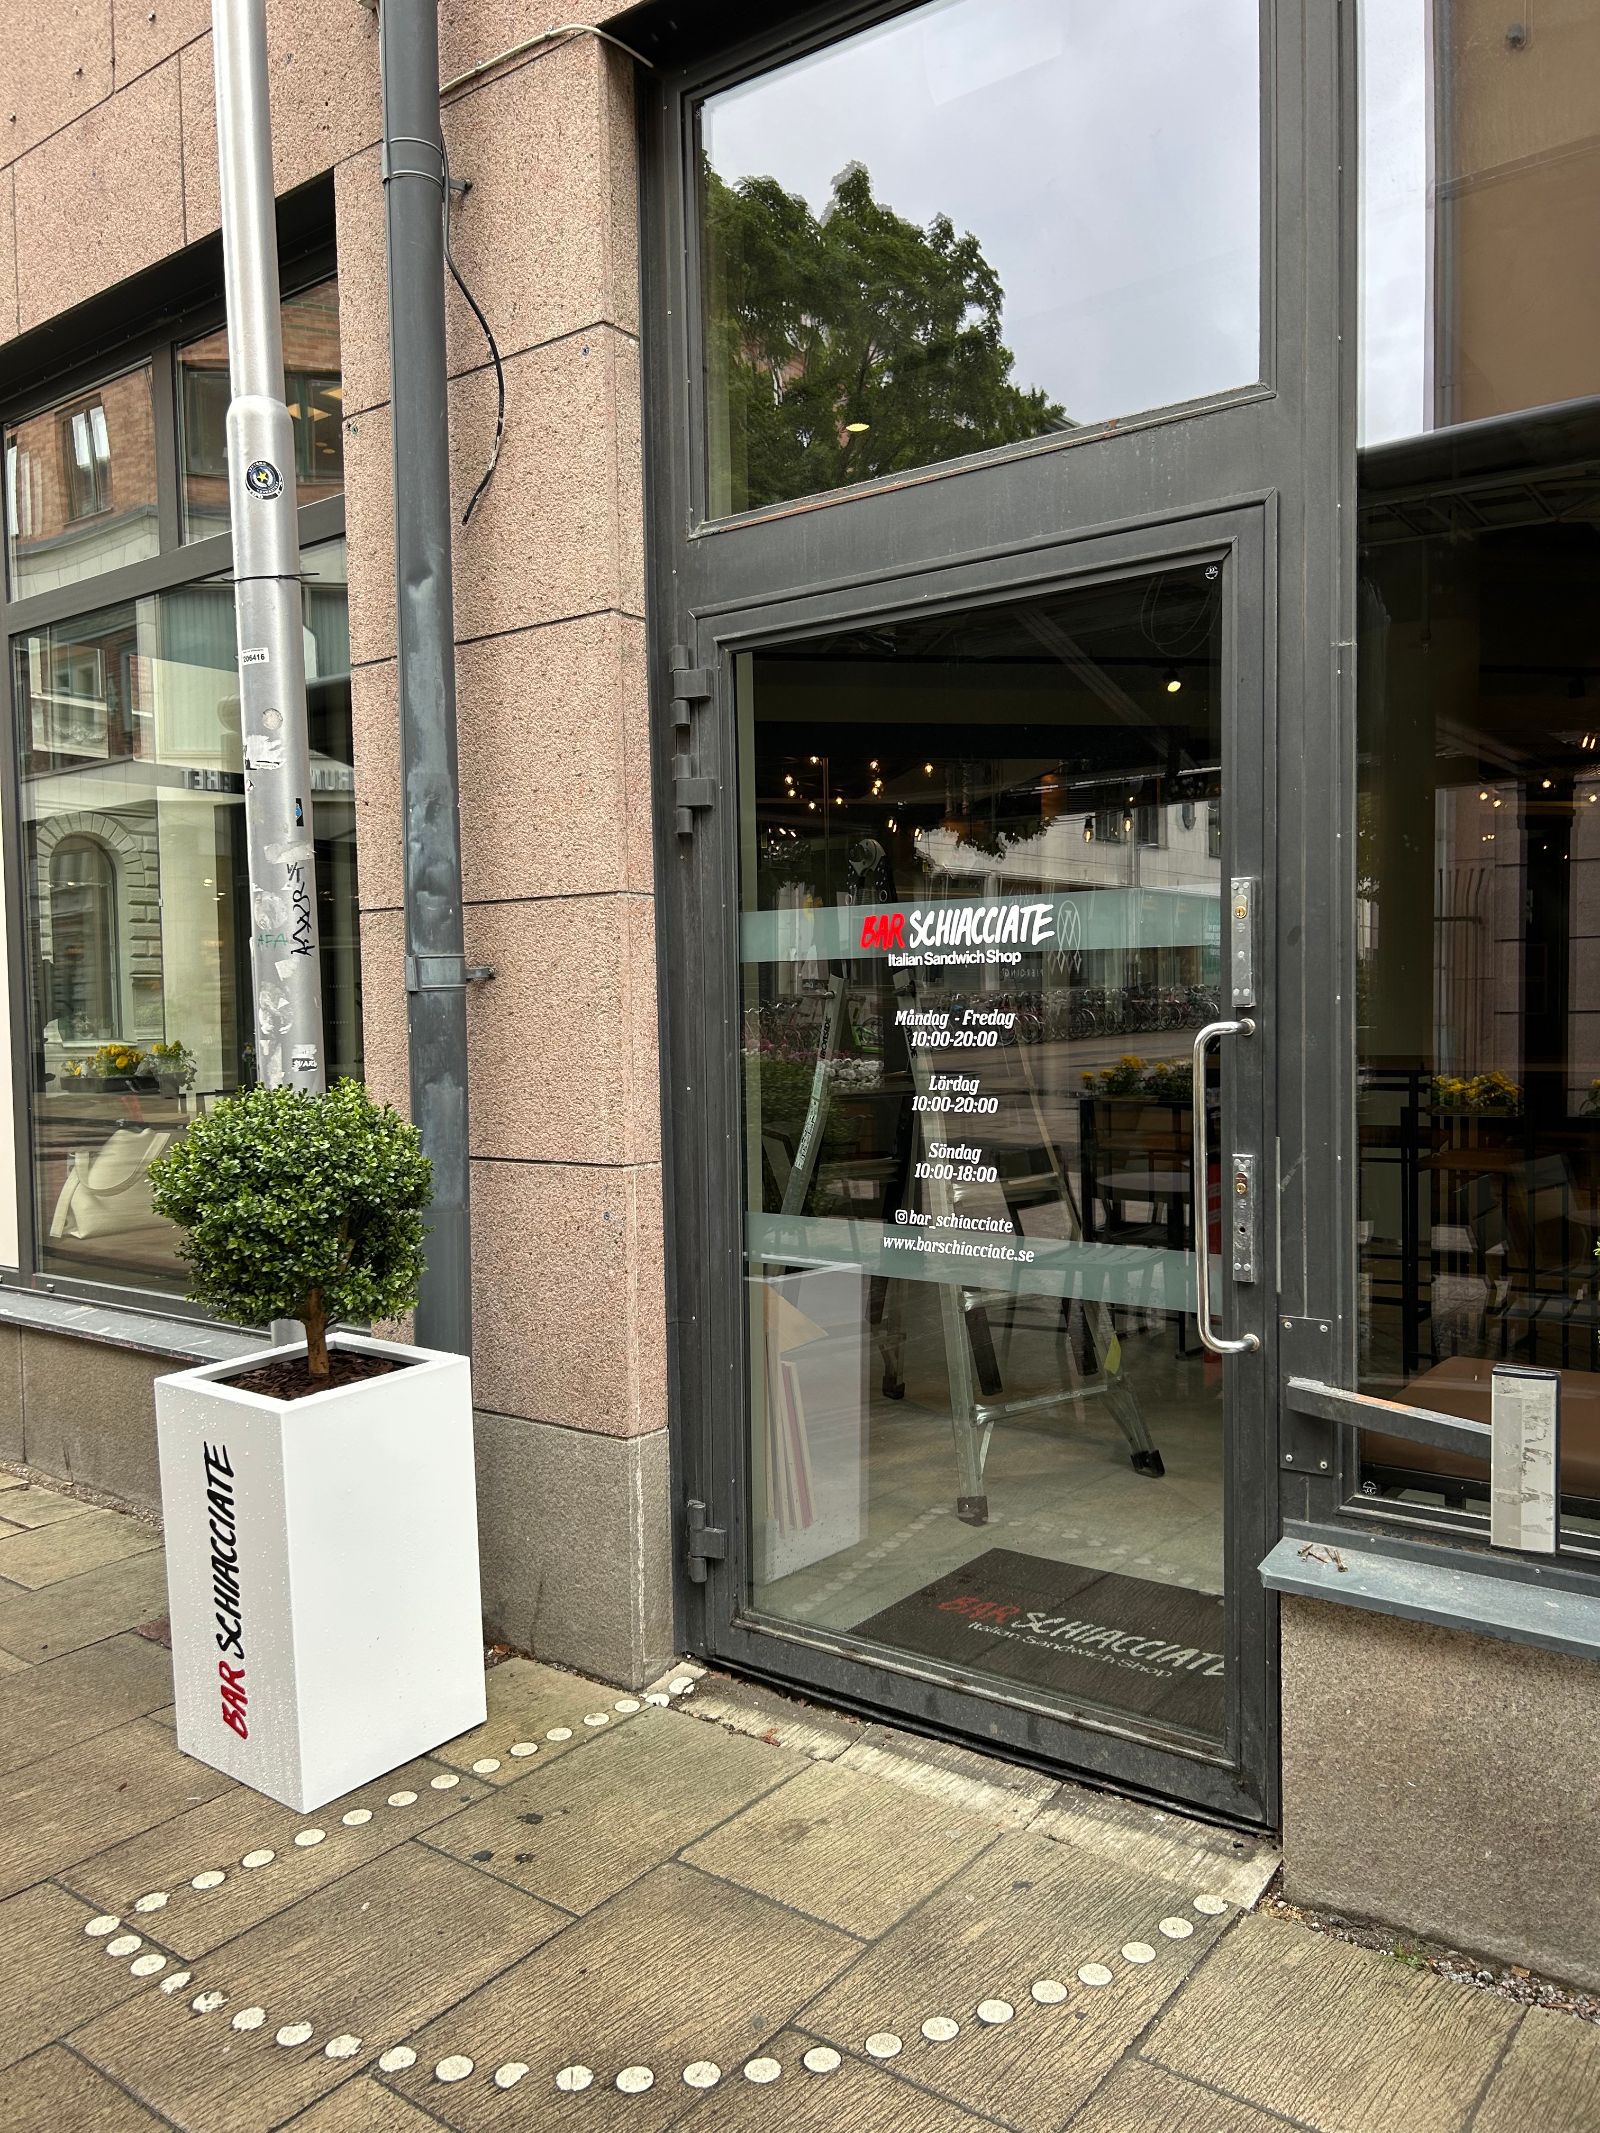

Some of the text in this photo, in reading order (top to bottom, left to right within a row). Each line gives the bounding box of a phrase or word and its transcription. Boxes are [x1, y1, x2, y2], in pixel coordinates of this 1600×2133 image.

[859, 902, 1056, 951] BAR SCHIACCIATE
[888, 950, 1022, 967] Italian Sandwich Shop
[894, 1008, 949, 1029] Måndag
[963, 1009, 1016, 1028] Fredag
[910, 1030, 998, 1048] 10:00-20:00
[928, 1075, 980, 1095] Lördag
[911, 1096, 999, 1114] 10:00-20:00
[928, 1142, 982, 1164] Söndag
[914, 1163, 998, 1183] 10:00-18:00
[909, 1211, 1014, 1234] bar_schiacciate
[883, 1236, 1035, 1264] www.barschiacciate.se
[203, 1440, 248, 1740] BAR SCHIACCIATE
[937, 1595, 1021, 1623] BAR
[968, 1621, 1173, 1678] Italian Sandwich Shop
